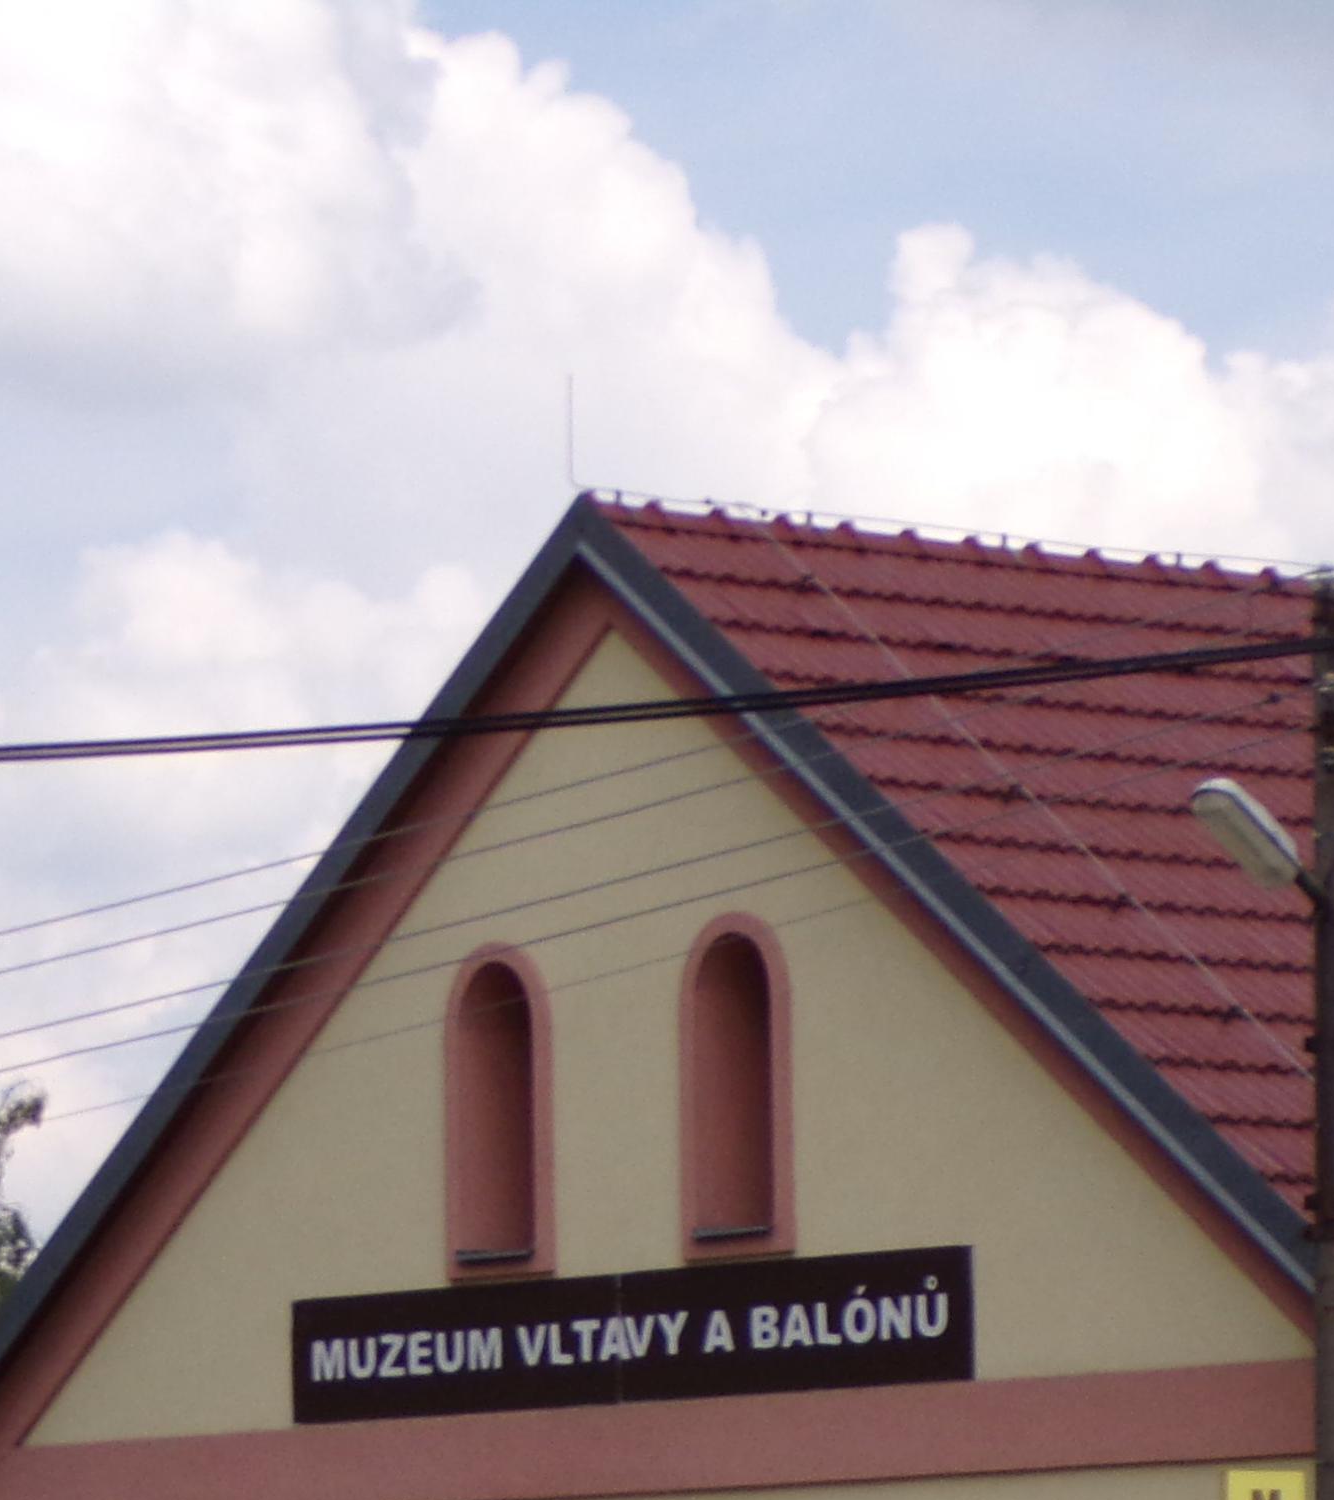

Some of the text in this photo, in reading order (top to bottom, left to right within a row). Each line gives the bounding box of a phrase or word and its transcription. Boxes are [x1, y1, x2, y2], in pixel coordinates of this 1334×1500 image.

[310, 1275, 950, 1382] MUZEUM VLTAVY A BALÓNŮ
